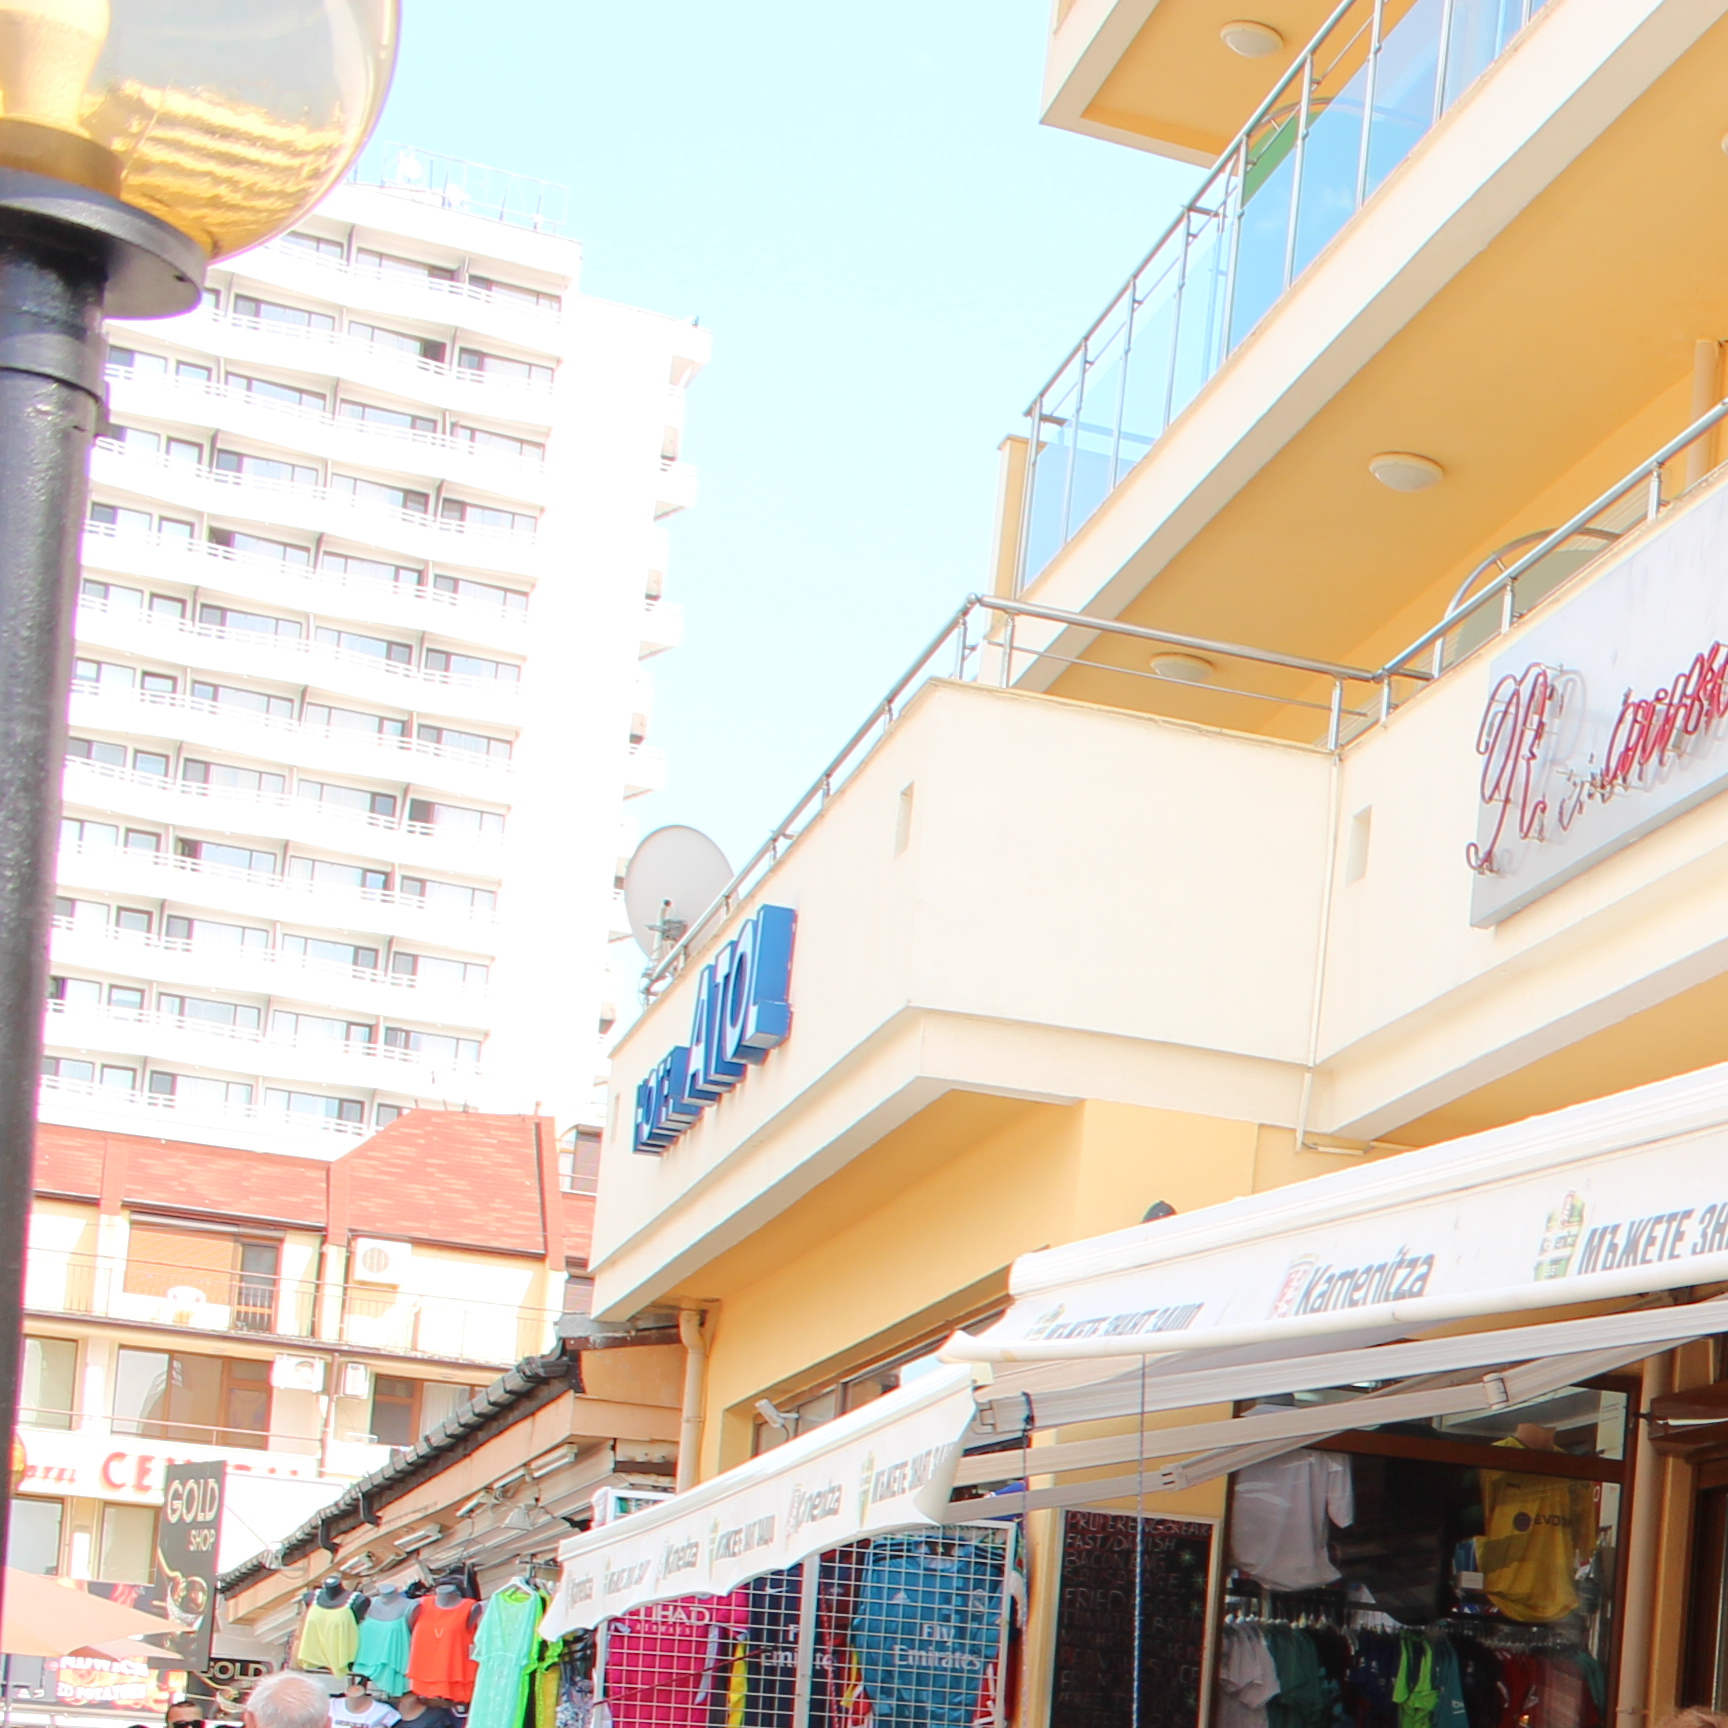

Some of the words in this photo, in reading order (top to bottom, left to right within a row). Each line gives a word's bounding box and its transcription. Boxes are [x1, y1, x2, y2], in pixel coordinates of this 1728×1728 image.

[1577, 1208, 1696, 1274] МЪЖЕТЕ
[1299, 1245, 1435, 1316] Kamenitza
[166, 1479, 219, 1523] GOLD
[189, 1529, 216, 1552] SHOP
[1065, 1588, 1126, 1610] FRIED
[922, 1623, 955, 1646] Fly
[893, 1645, 981, 1670] Emirates
